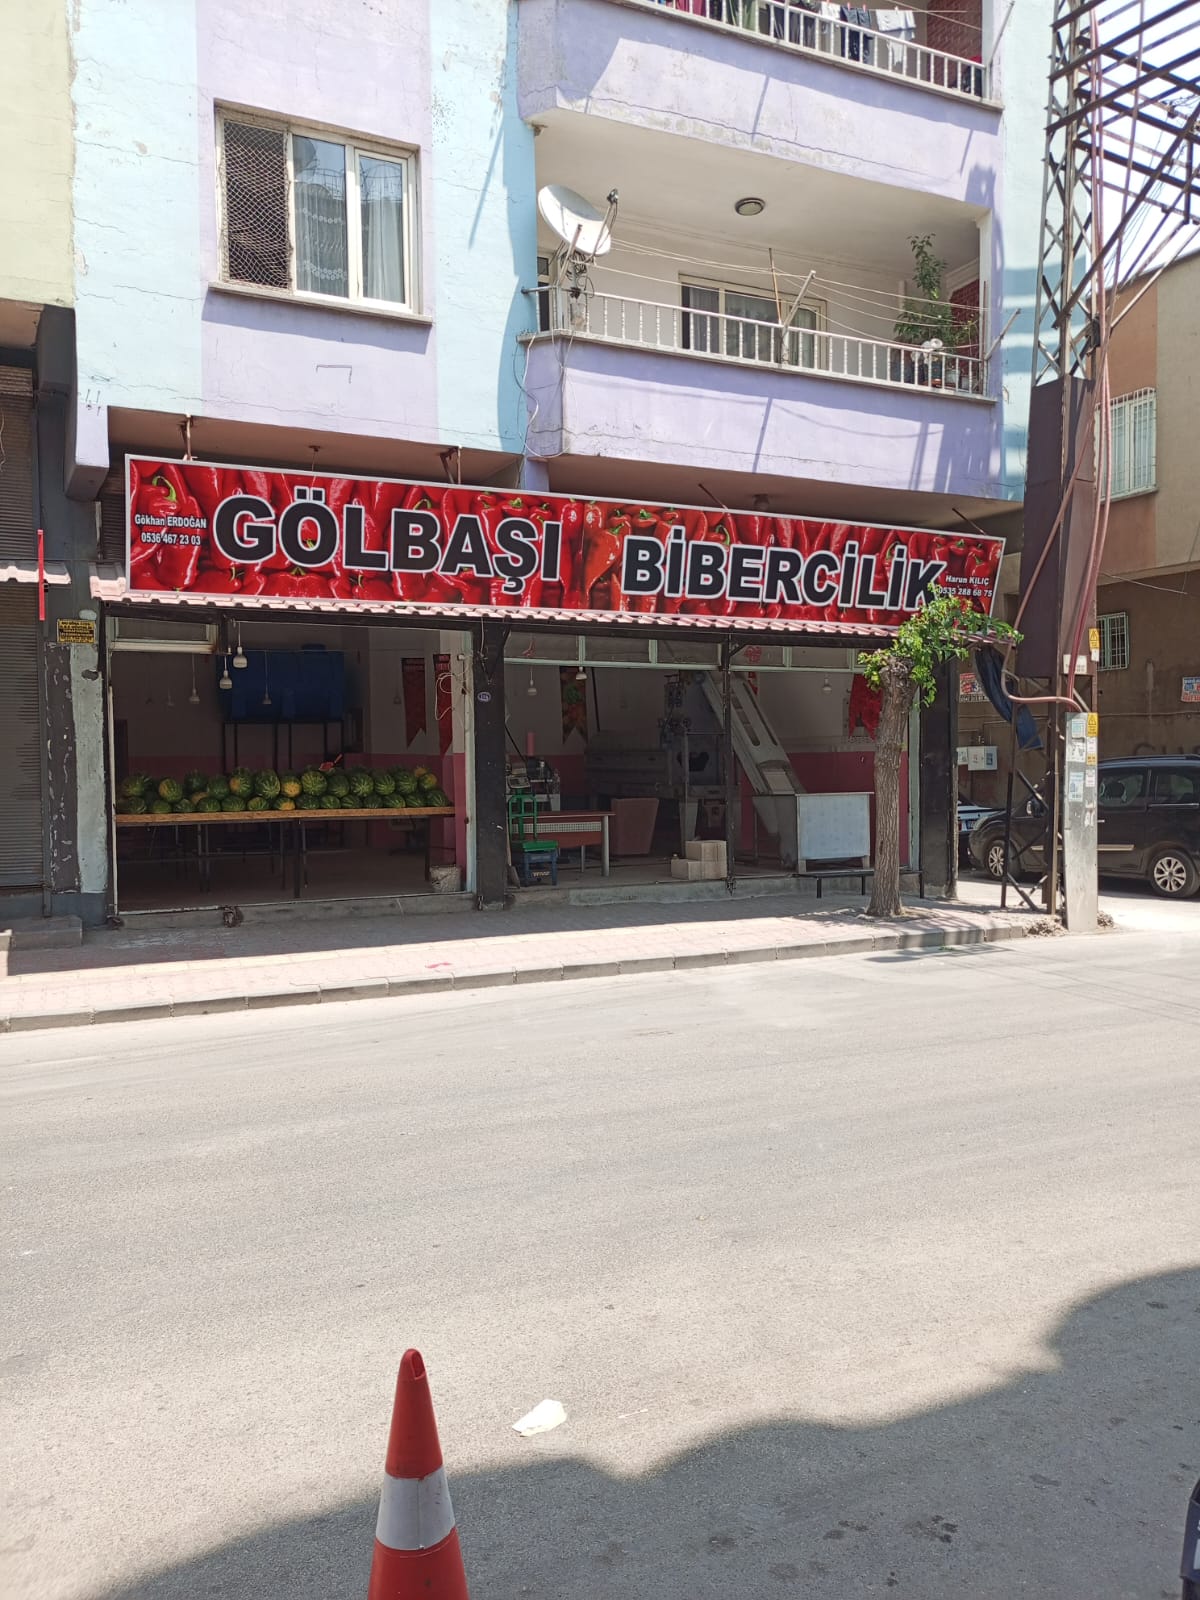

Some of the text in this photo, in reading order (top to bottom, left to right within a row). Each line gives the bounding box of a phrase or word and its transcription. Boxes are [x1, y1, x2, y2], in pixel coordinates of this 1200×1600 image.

[135, 514, 207, 528] Gökhan ERDOĞAN
[141, 532, 201, 546] 0536 467 23 03
[213, 486, 947, 611] GÖLBAŞI BİBERCİLİK
[945, 575, 967, 583] Harun
[957, 588, 971, 596] 288
[983, 589, 993, 598] 75
